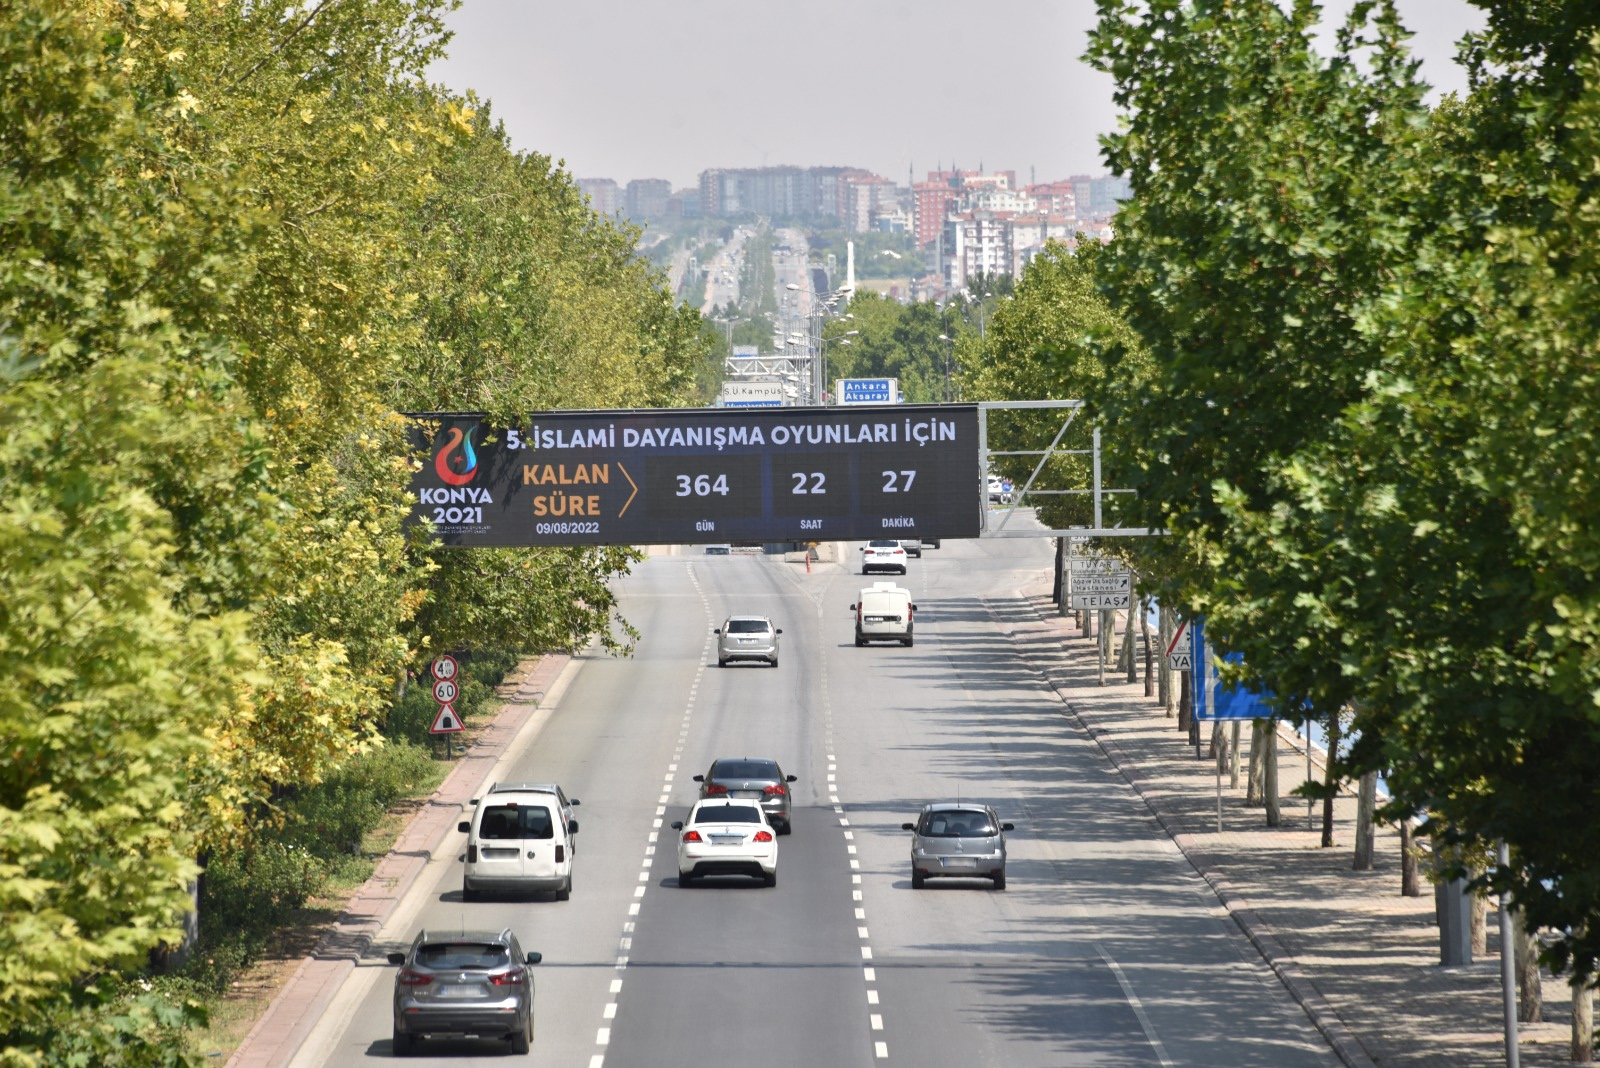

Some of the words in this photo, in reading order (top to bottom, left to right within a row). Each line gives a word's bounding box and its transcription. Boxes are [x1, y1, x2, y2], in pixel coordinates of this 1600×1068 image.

[846, 382, 887, 391] Ankara
[845, 392, 889, 401] Aksaray
[507, 430, 526, 449] 5.
[533, 424, 615, 449] İSLAMİ
[623, 426, 766, 451] DAYANIŞMA
[770, 423, 897, 445] OYUNLARI
[905, 417, 956, 447] İÇİN
[523, 464, 609, 485] KALAN
[675, 474, 730, 497] 364
[791, 472, 827, 495] 22
[882, 470, 917, 493] 27
[420, 488, 493, 505] KONYA
[533, 491, 601, 516] SÜRE
[433, 507, 482, 524] 2021
[882, 516, 915, 528] DAKİKA
[536, 522, 600, 535] 09/08/2022
[695, 519, 715, 532] GÜN
[800, 519, 823, 529] SAAT
[1171, 655, 1191, 667] YA
[438, 685, 454, 697] 60
